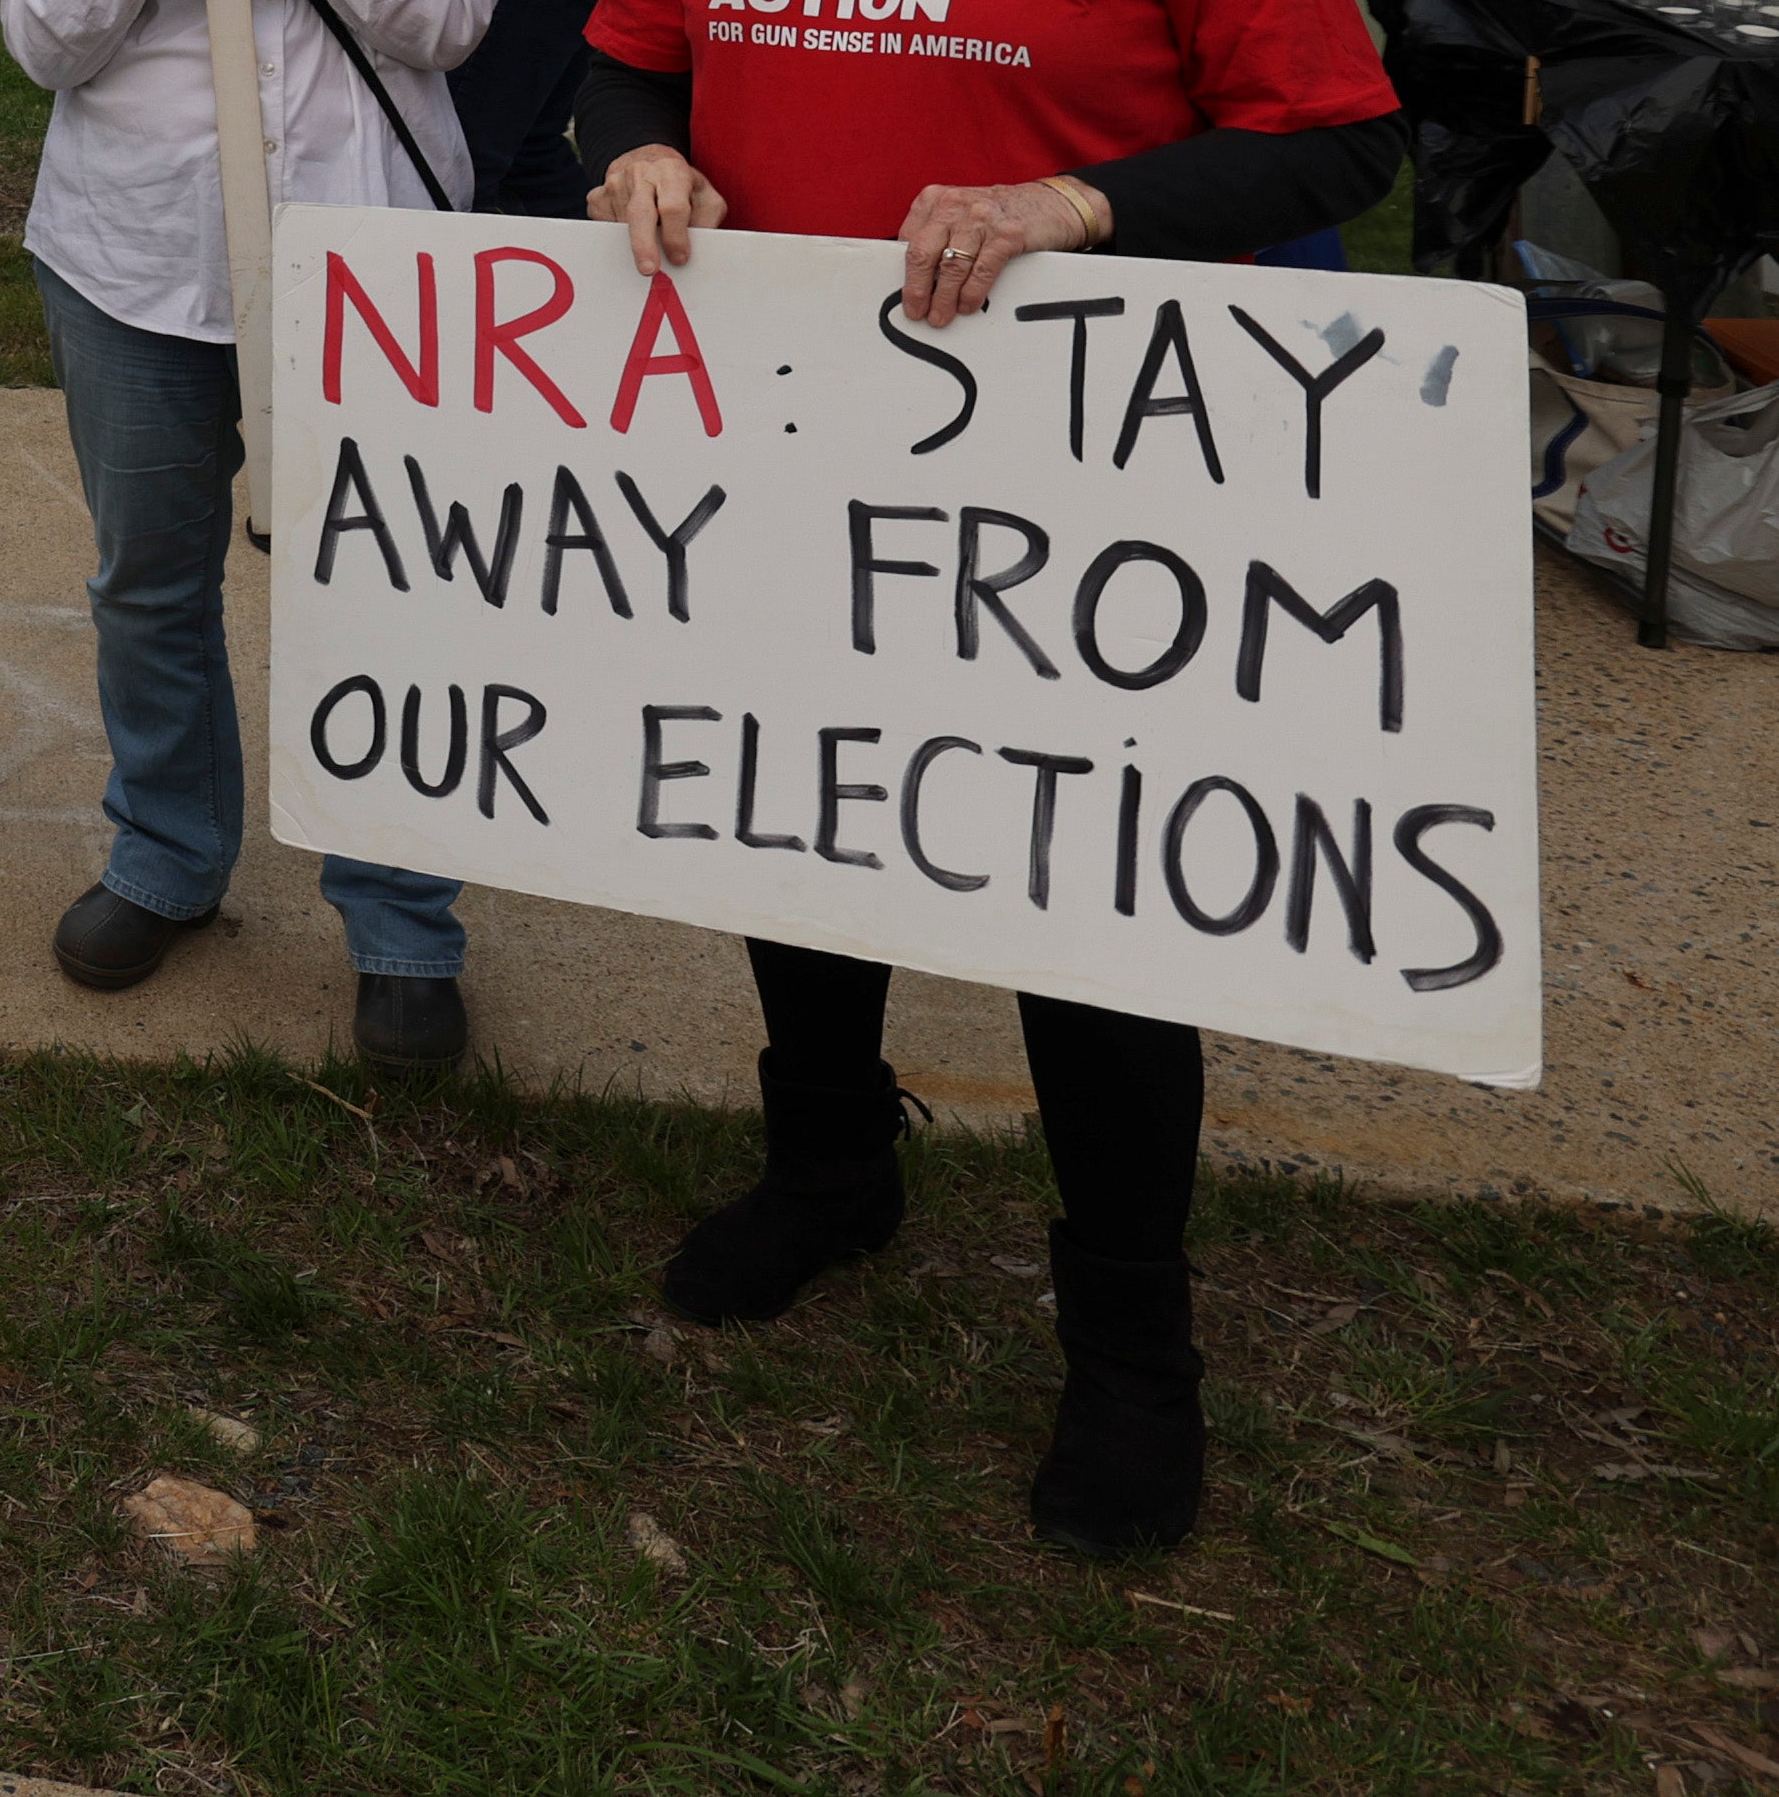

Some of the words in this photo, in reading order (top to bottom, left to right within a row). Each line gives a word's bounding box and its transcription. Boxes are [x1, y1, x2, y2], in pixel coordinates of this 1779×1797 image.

[708, 21, 743, 43] FOR
[750, 24, 797, 47] GUN
[803, 28, 874, 53] SENSE
[879, 32, 902, 54] IN
[908, 34, 1032, 68] AMERICA
[879, 285, 1386, 499] STAY
[313, 436, 728, 623] AWAY
[847, 497, 1404, 733] FROM
[309, 674, 550, 826] OUR
